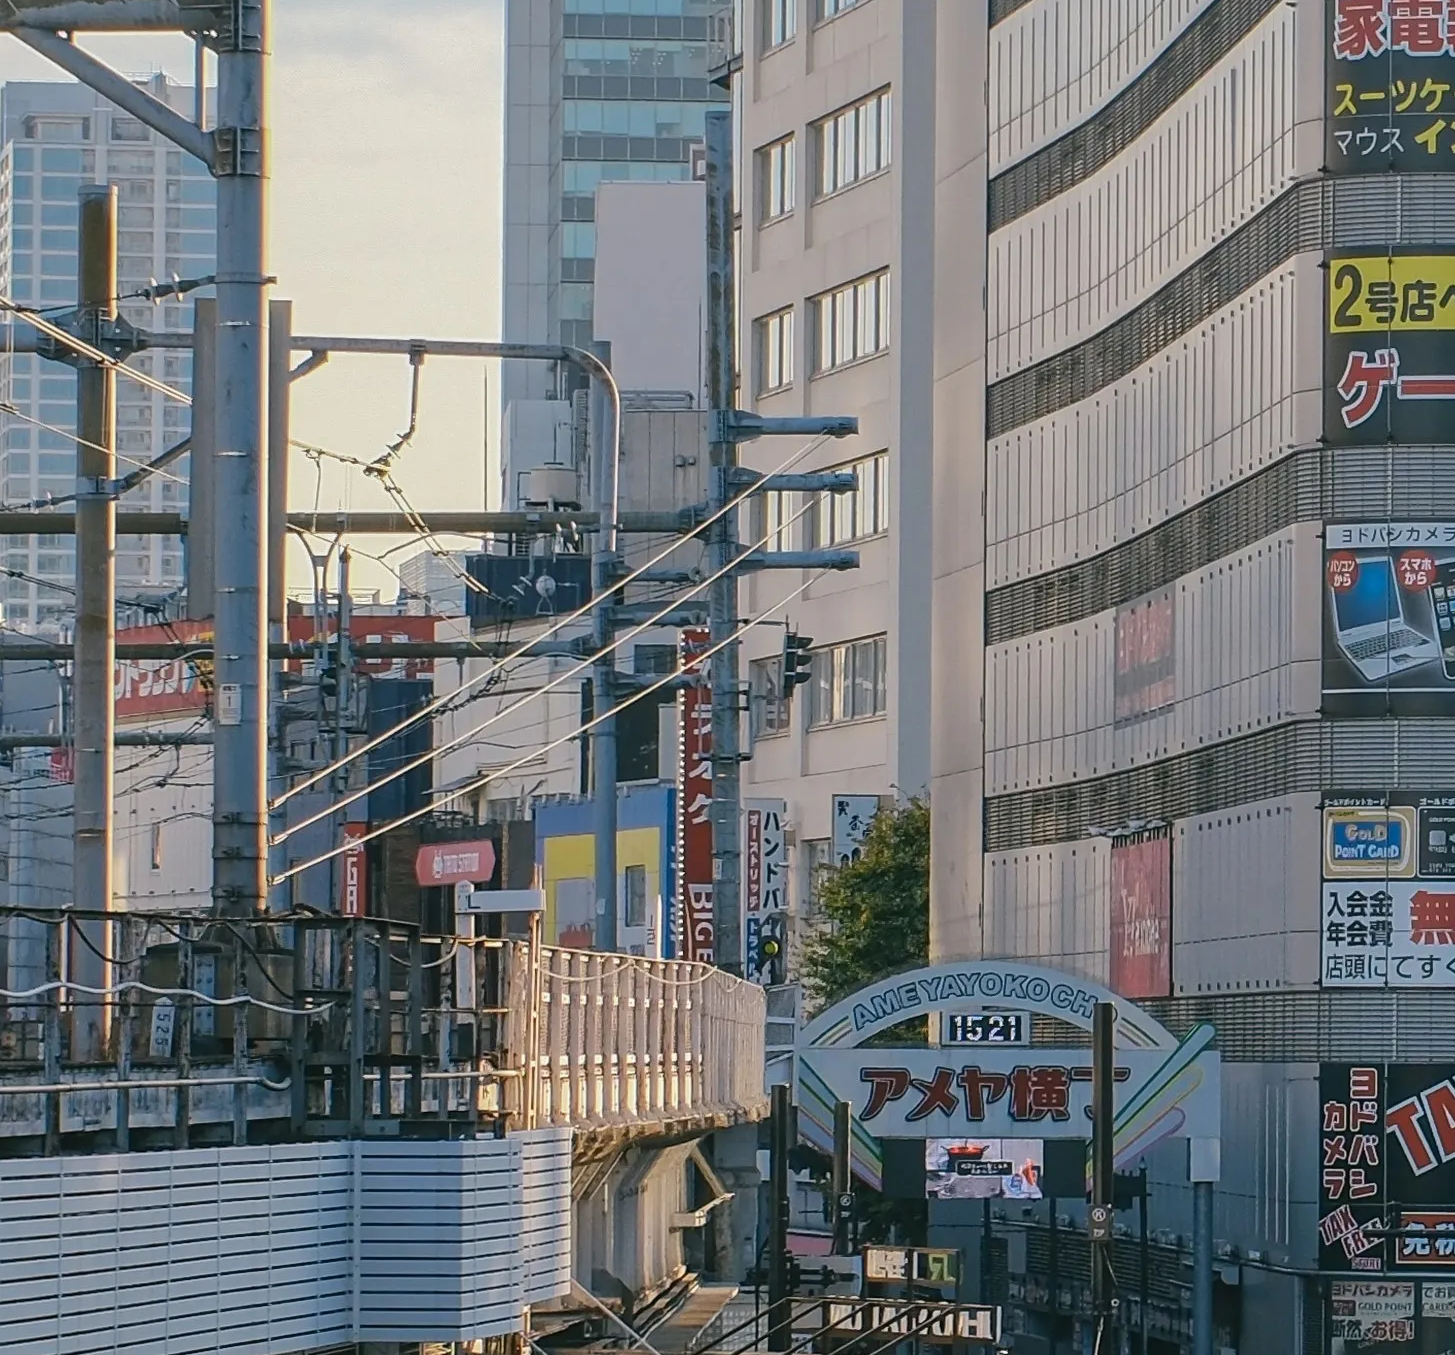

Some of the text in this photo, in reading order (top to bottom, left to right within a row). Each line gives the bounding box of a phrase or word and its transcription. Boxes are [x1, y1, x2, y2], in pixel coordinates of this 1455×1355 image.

[1333, 127, 1404, 155] マウス
[1329, 558, 1355, 571] パソコン
[1400, 557, 1432, 570] スマホ
[1333, 573, 1352, 586] から
[1405, 571, 1427, 585] から
[748, 811, 760, 910] オーストリッチ
[1327, 891, 1394, 919] 入会金
[1327, 920, 1394, 948] 年会費
[853, 971, 1118, 1031] AMEYAYOKOCH
[1348, 1067, 1378, 1198] ヨドバシ
[1323, 1101, 1346, 1199] カメラ
[1318, 1204, 1359, 1245] TAX
[1332, 1283, 1413, 1297] ヨドバシカメラ
